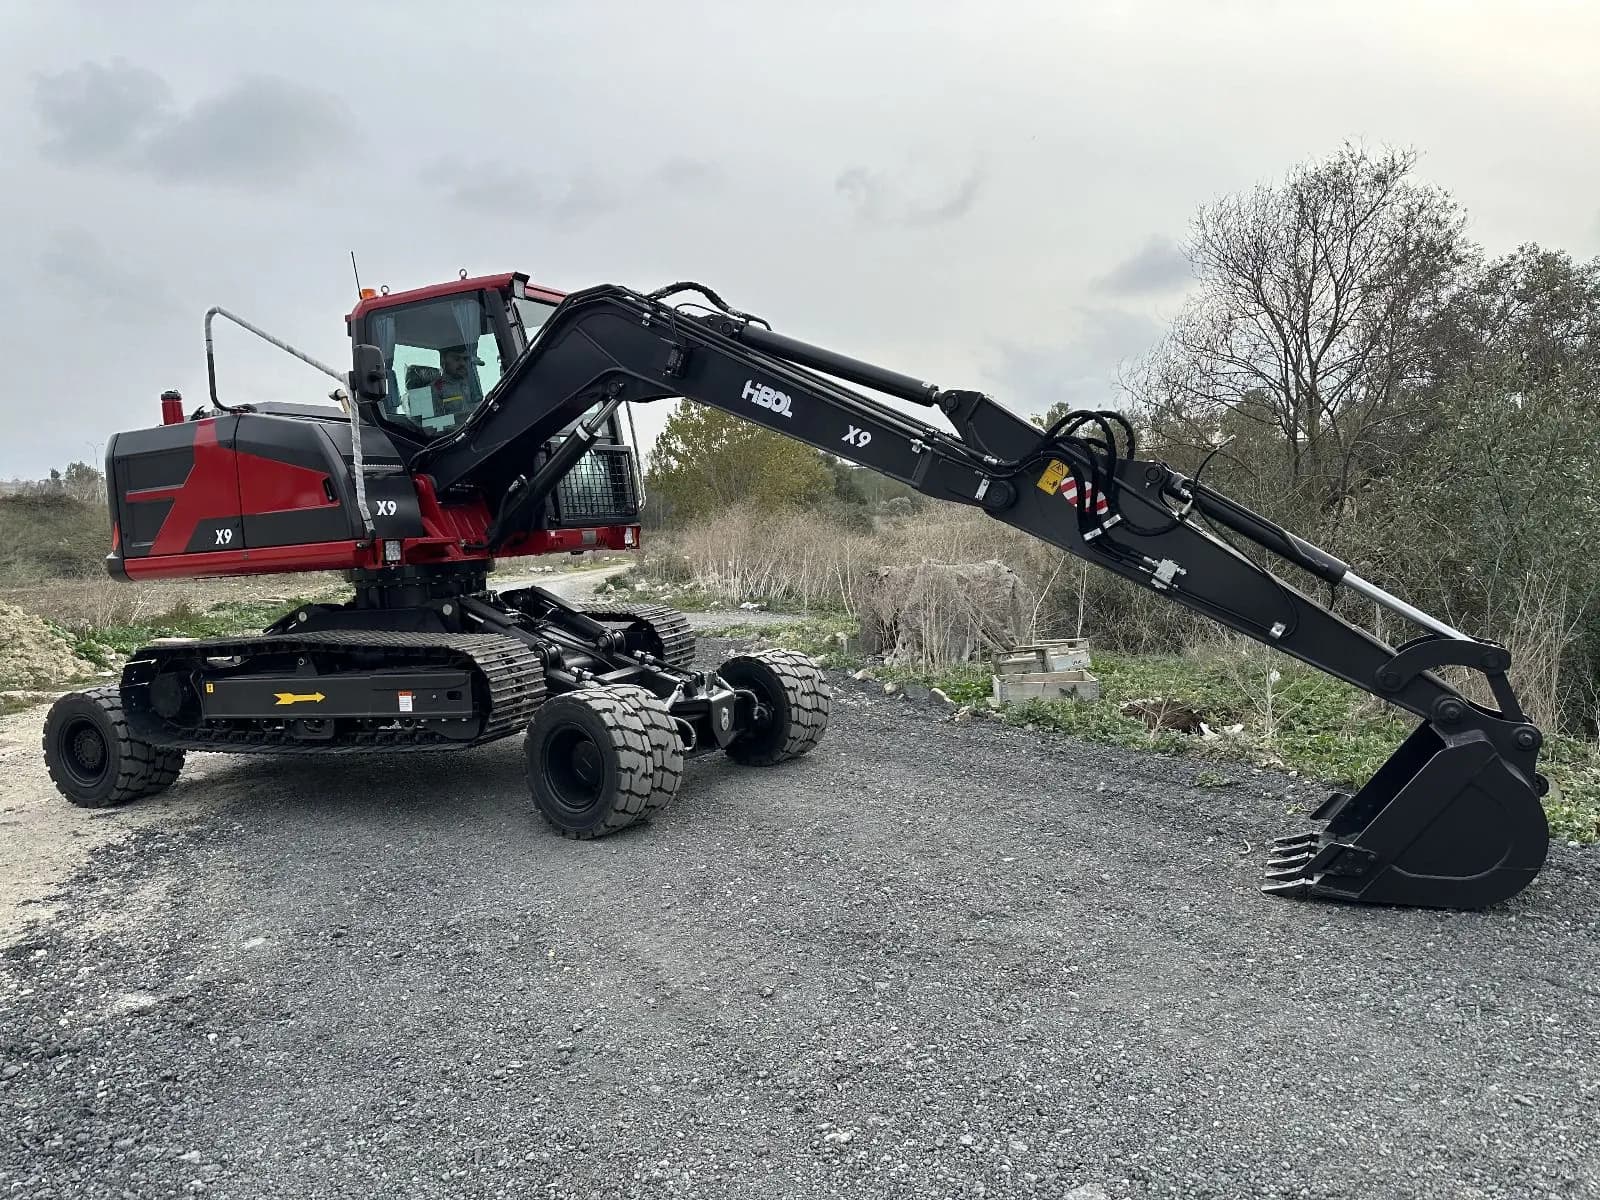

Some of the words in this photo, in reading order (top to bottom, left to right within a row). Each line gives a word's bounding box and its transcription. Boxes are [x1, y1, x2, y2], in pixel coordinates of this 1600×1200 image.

[841, 424, 872, 448] X9
[376, 501, 397, 516] X9
[215, 529, 232, 545] X9
